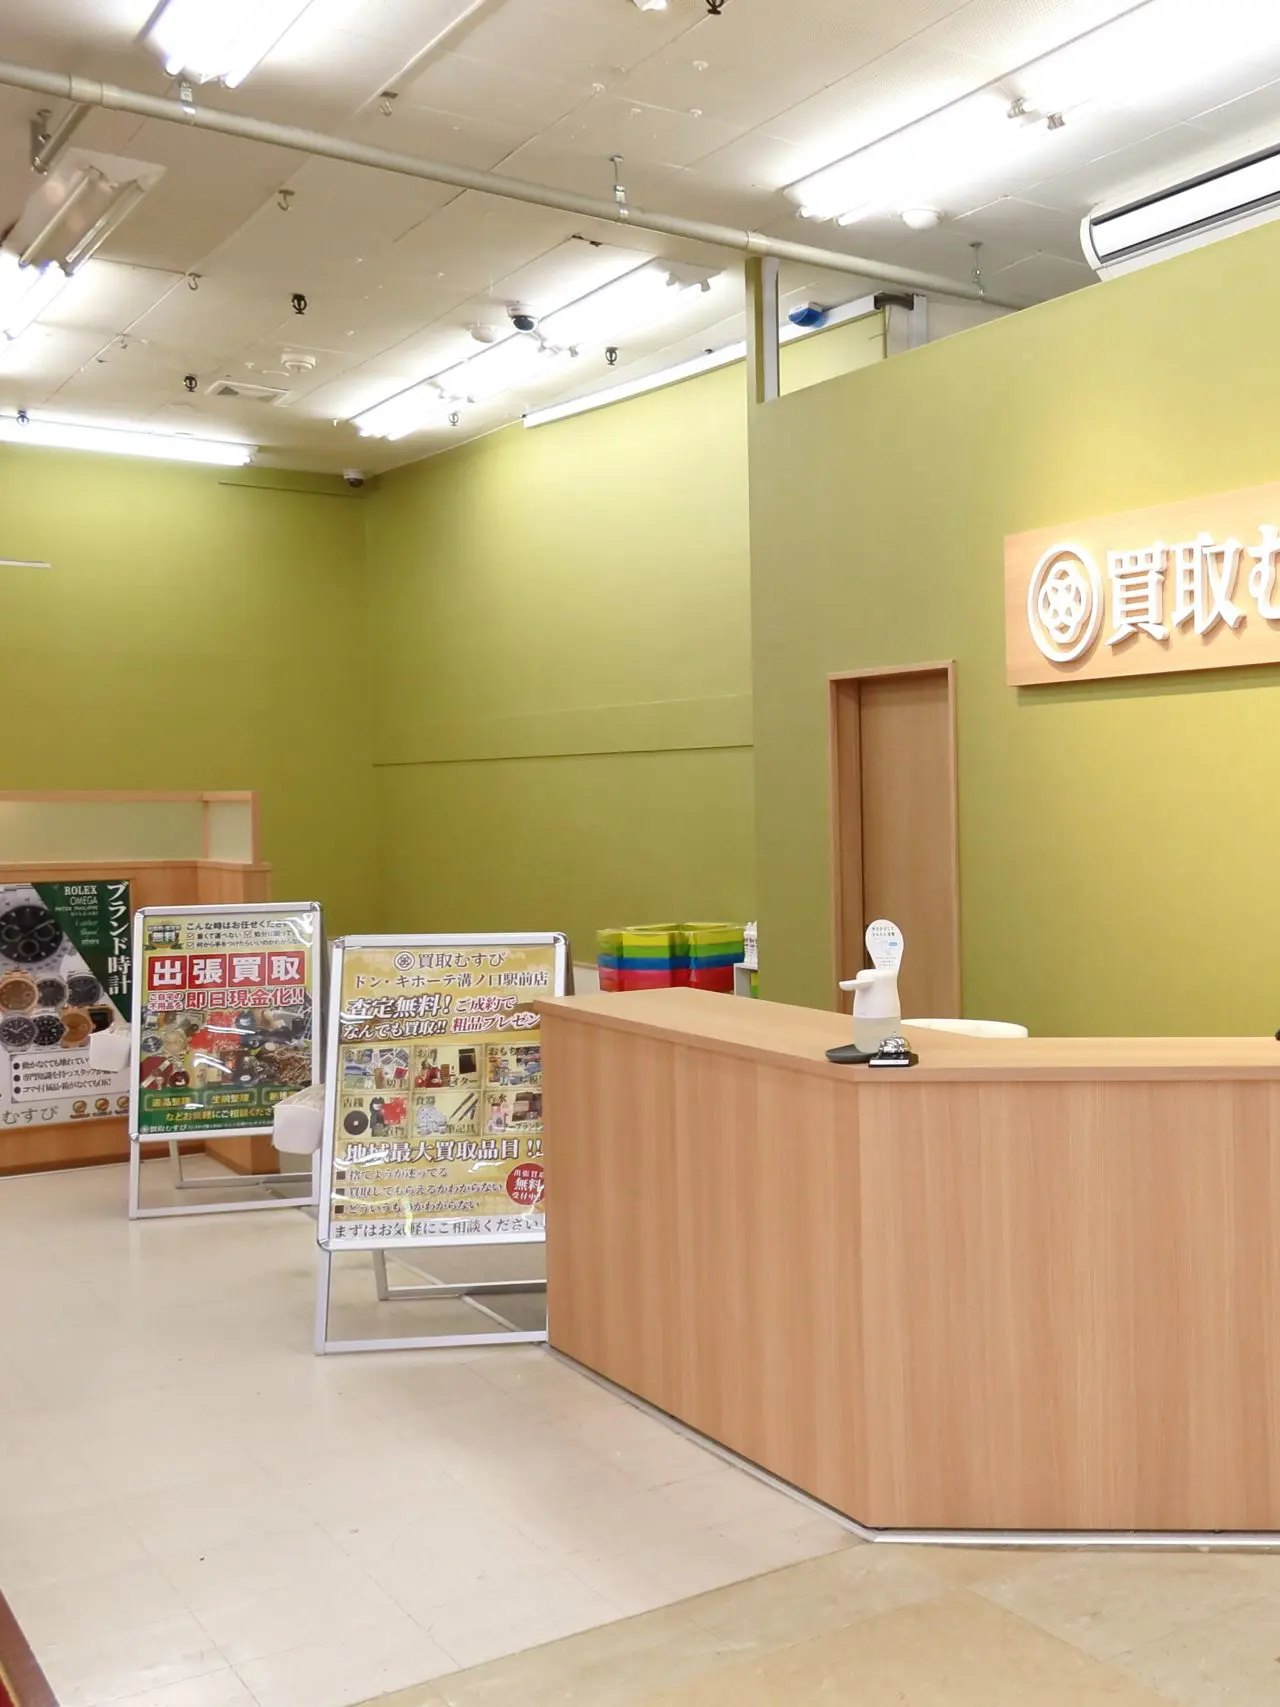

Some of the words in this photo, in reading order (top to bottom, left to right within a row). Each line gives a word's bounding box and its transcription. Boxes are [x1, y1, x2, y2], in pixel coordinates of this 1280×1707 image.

[64, 886, 98, 896] ROLEX
[69, 896, 98, 906] OMEGA
[107, 881, 131, 995] ブランド時計
[418, 952, 505, 969] 買取むすび
[153, 955, 300, 986] 出張買取
[455, 996, 516, 1013] ご成約で
[2, 1105, 59, 1125] むすび
